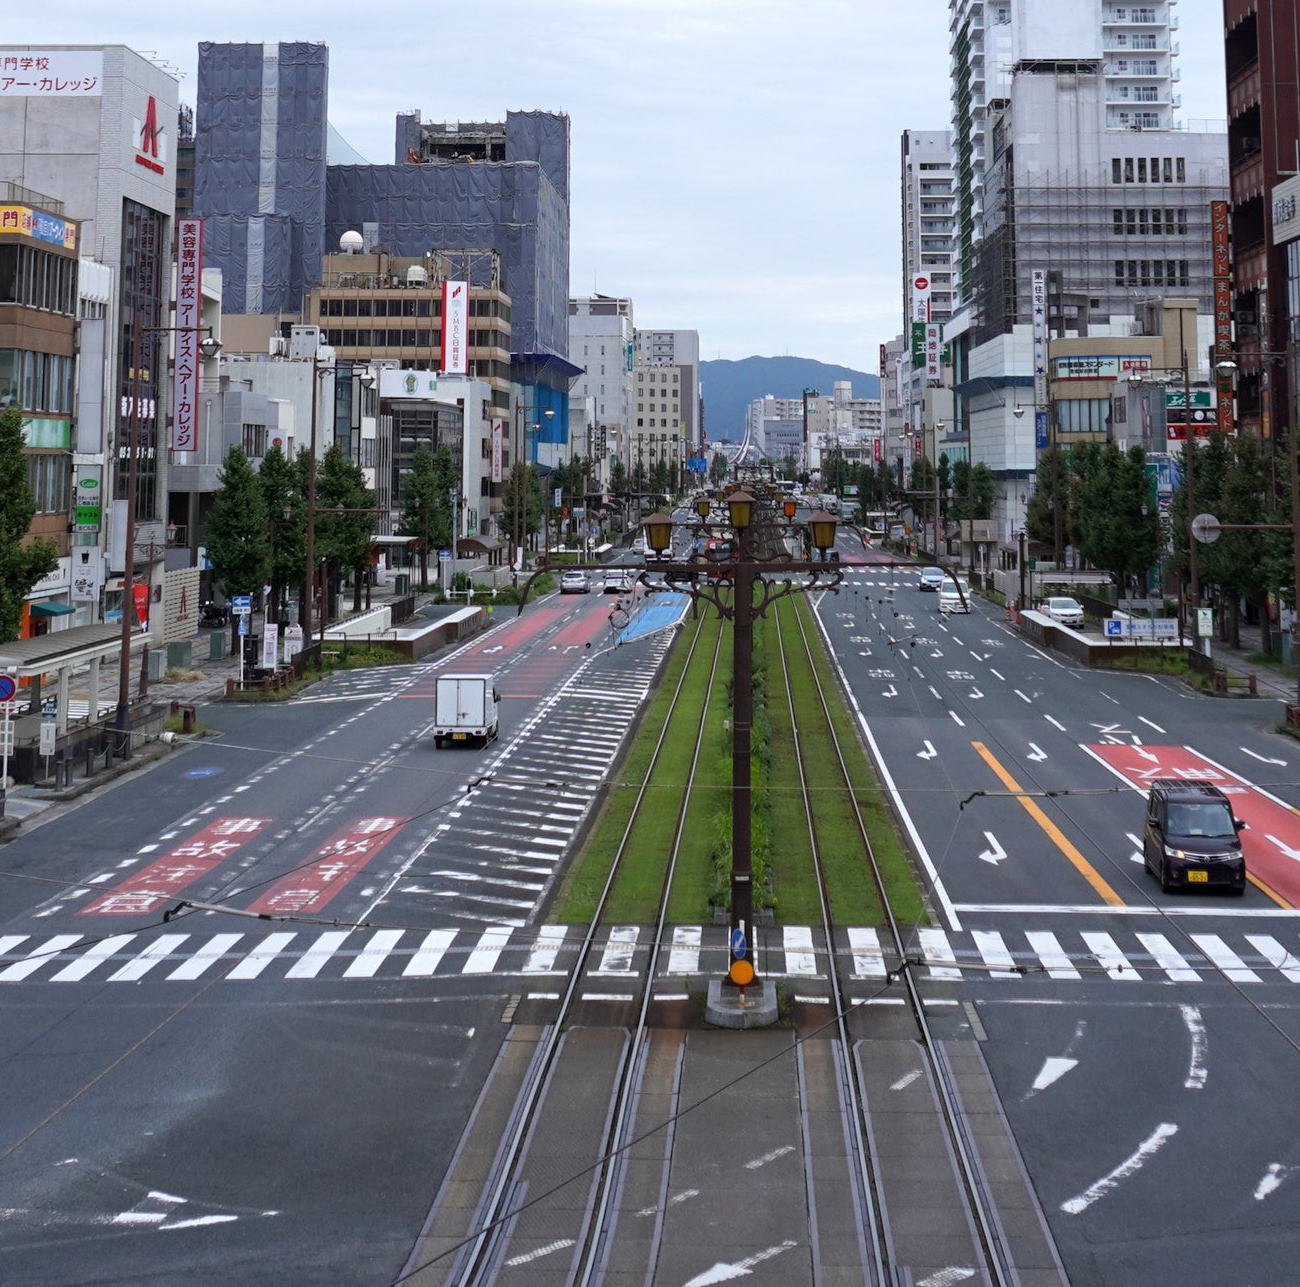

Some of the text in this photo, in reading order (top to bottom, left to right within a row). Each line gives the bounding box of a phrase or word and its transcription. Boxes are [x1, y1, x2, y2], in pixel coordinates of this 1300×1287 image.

[181, 223, 197, 299] 美容専門学校
[1213, 203, 1229, 274] インターネット
[1034, 271, 1044, 304] 第一住宅
[1216, 281, 1230, 351] まんが喫茶
[928, 328, 937, 375] 岡地証券
